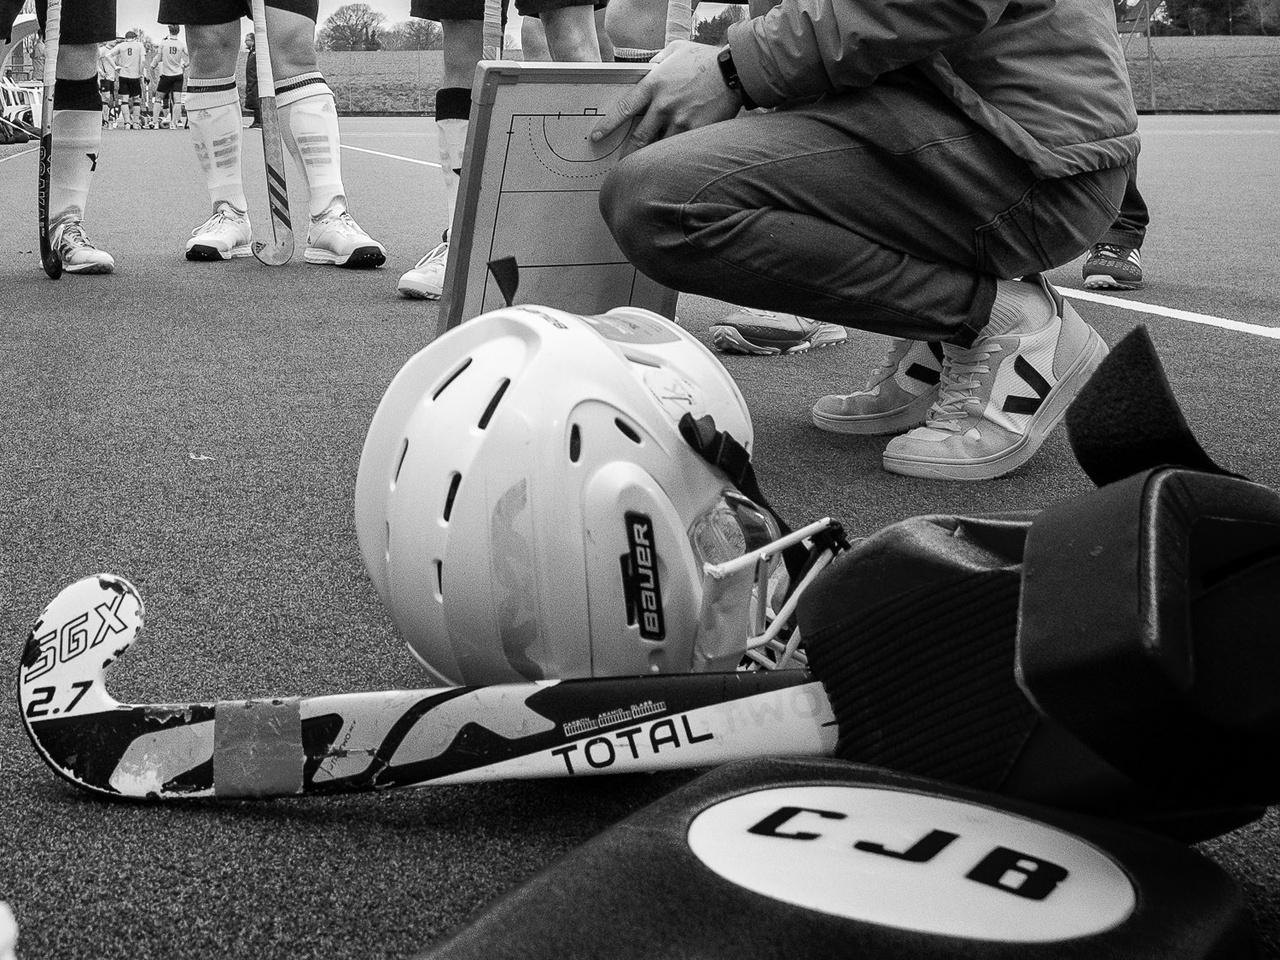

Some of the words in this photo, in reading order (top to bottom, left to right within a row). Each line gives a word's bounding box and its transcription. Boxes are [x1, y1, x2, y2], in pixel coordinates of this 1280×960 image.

[127, 47, 133, 56] 8
[169, 46, 178, 55] 19
[633, 523, 660, 634] BAUER
[25, 680, 94, 719] 2.7
[551, 715, 714, 775] TOTAL
